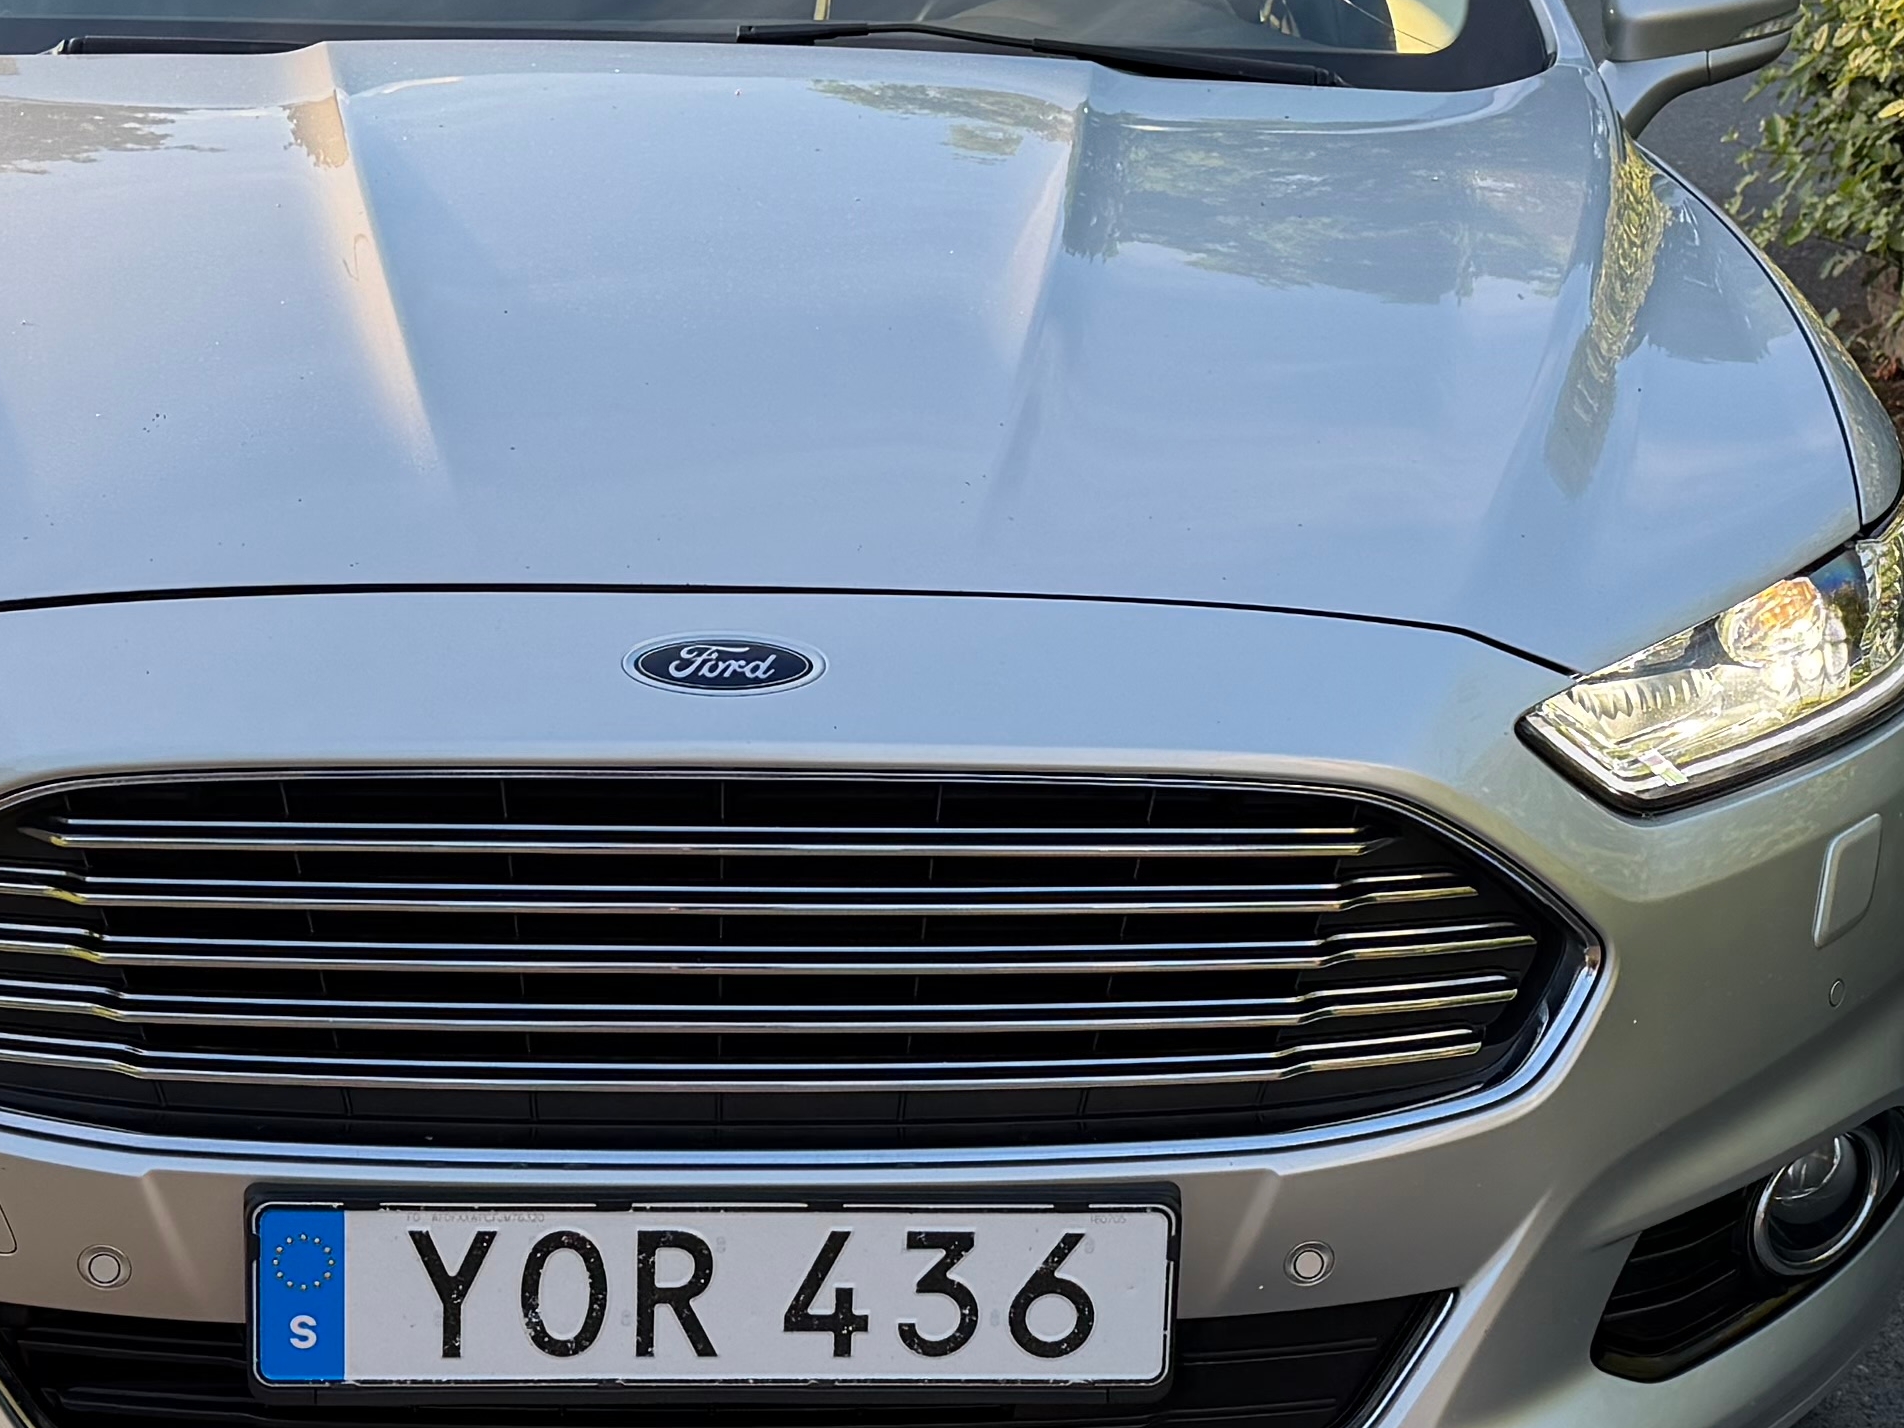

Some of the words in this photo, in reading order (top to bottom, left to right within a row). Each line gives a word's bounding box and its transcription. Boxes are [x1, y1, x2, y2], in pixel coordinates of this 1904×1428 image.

[668, 644, 777, 680] Ford
[408, 1230, 718, 1359] YOR
[783, 1230, 1095, 1359] 436
[289, 1314, 318, 1350] S
